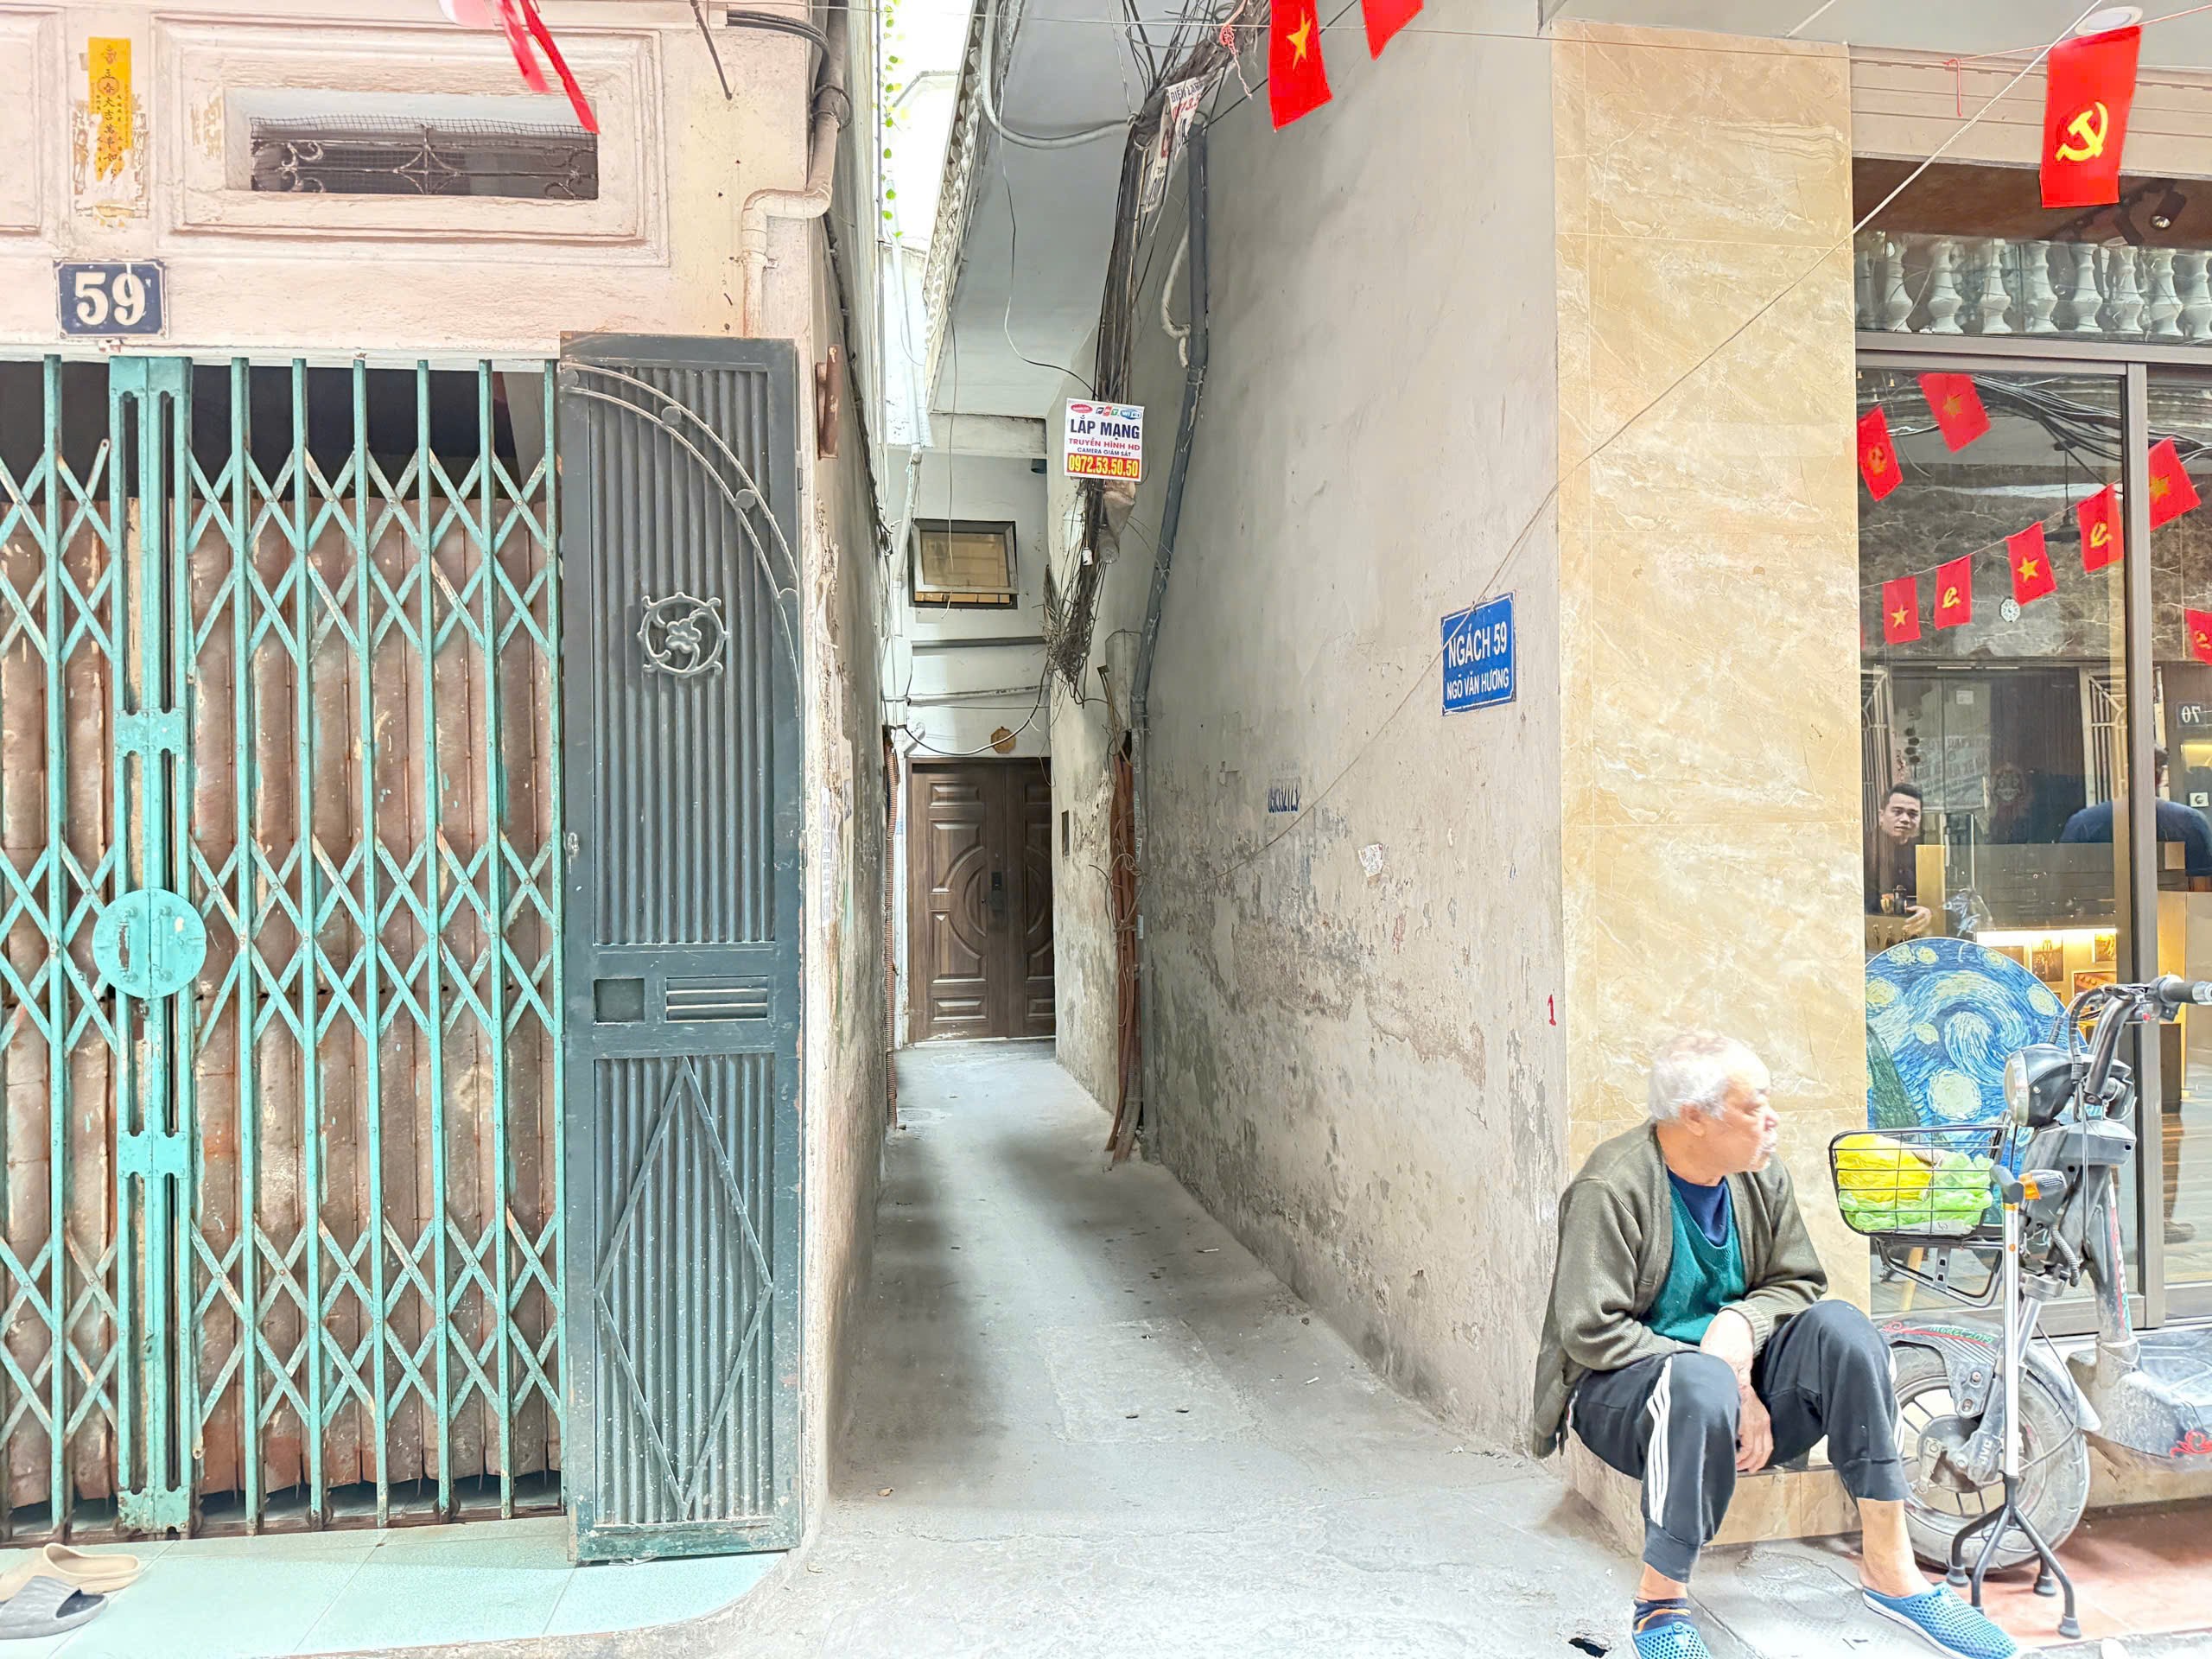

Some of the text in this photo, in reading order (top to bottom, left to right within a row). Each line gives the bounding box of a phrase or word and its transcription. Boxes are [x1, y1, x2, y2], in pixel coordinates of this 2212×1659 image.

[75, 271, 146, 326] 59
[1070, 415, 1140, 441] LẮP MẠNG
[1103, 441, 1126, 450] HÌNH
[1068, 454, 1139, 478] 0972.53.50.50
[1448, 620, 1508, 669] NGÁCH 59
[1464, 671, 1480, 696] VĂN
